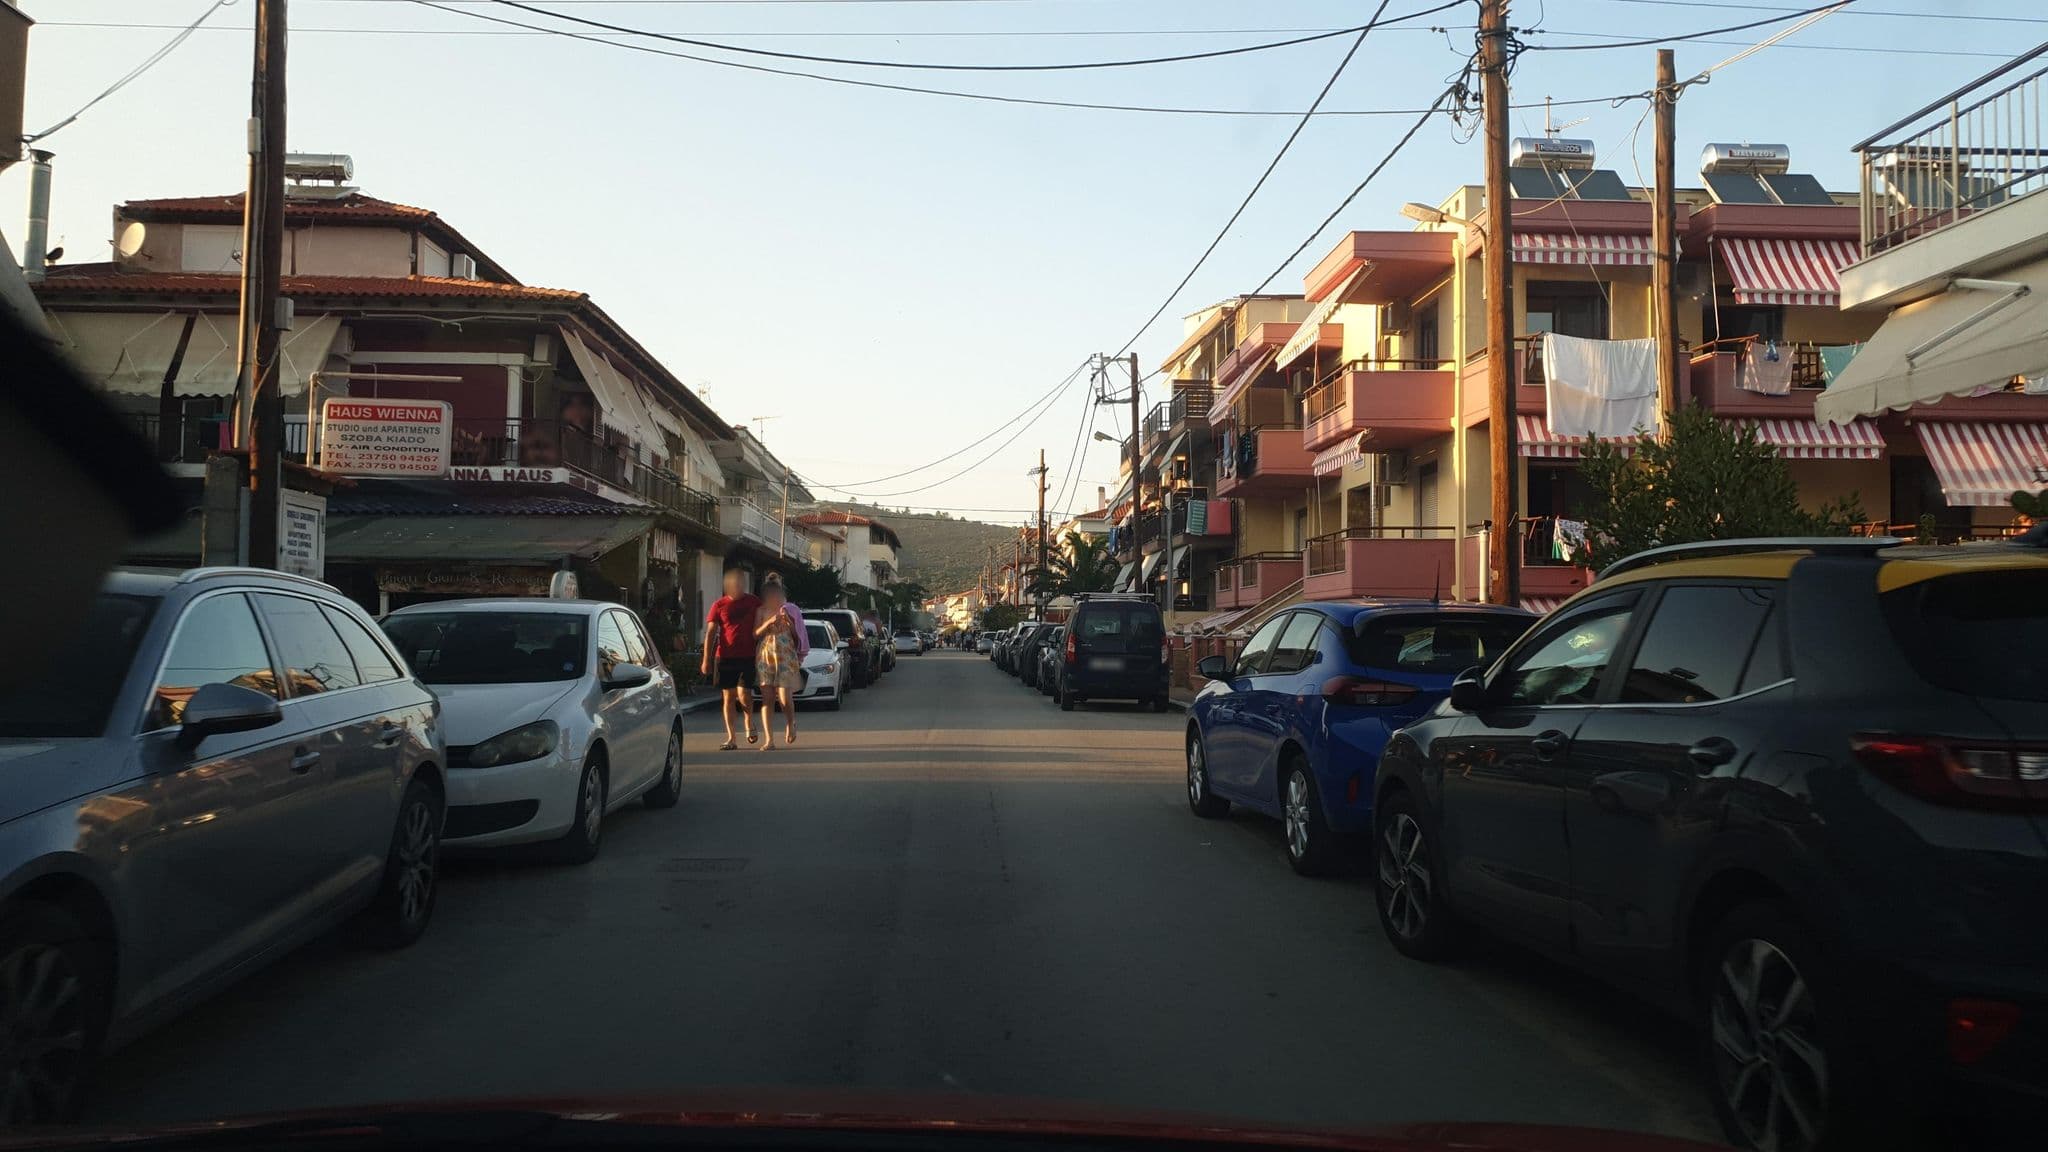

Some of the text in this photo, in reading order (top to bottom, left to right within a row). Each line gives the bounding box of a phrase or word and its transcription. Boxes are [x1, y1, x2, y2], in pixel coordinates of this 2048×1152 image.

[329, 406, 439, 420] HAUS WIENNA
[327, 423, 441, 435] STUDIO und APARTMENTS
[340, 434, 382, 442] SZOBA
[359, 453, 397, 461] 23750
[399, 454, 438, 462] 94267
[359, 462, 396, 470] 23750
[399, 463, 438, 471] 94502
[503, 468, 553, 481] HAUS
